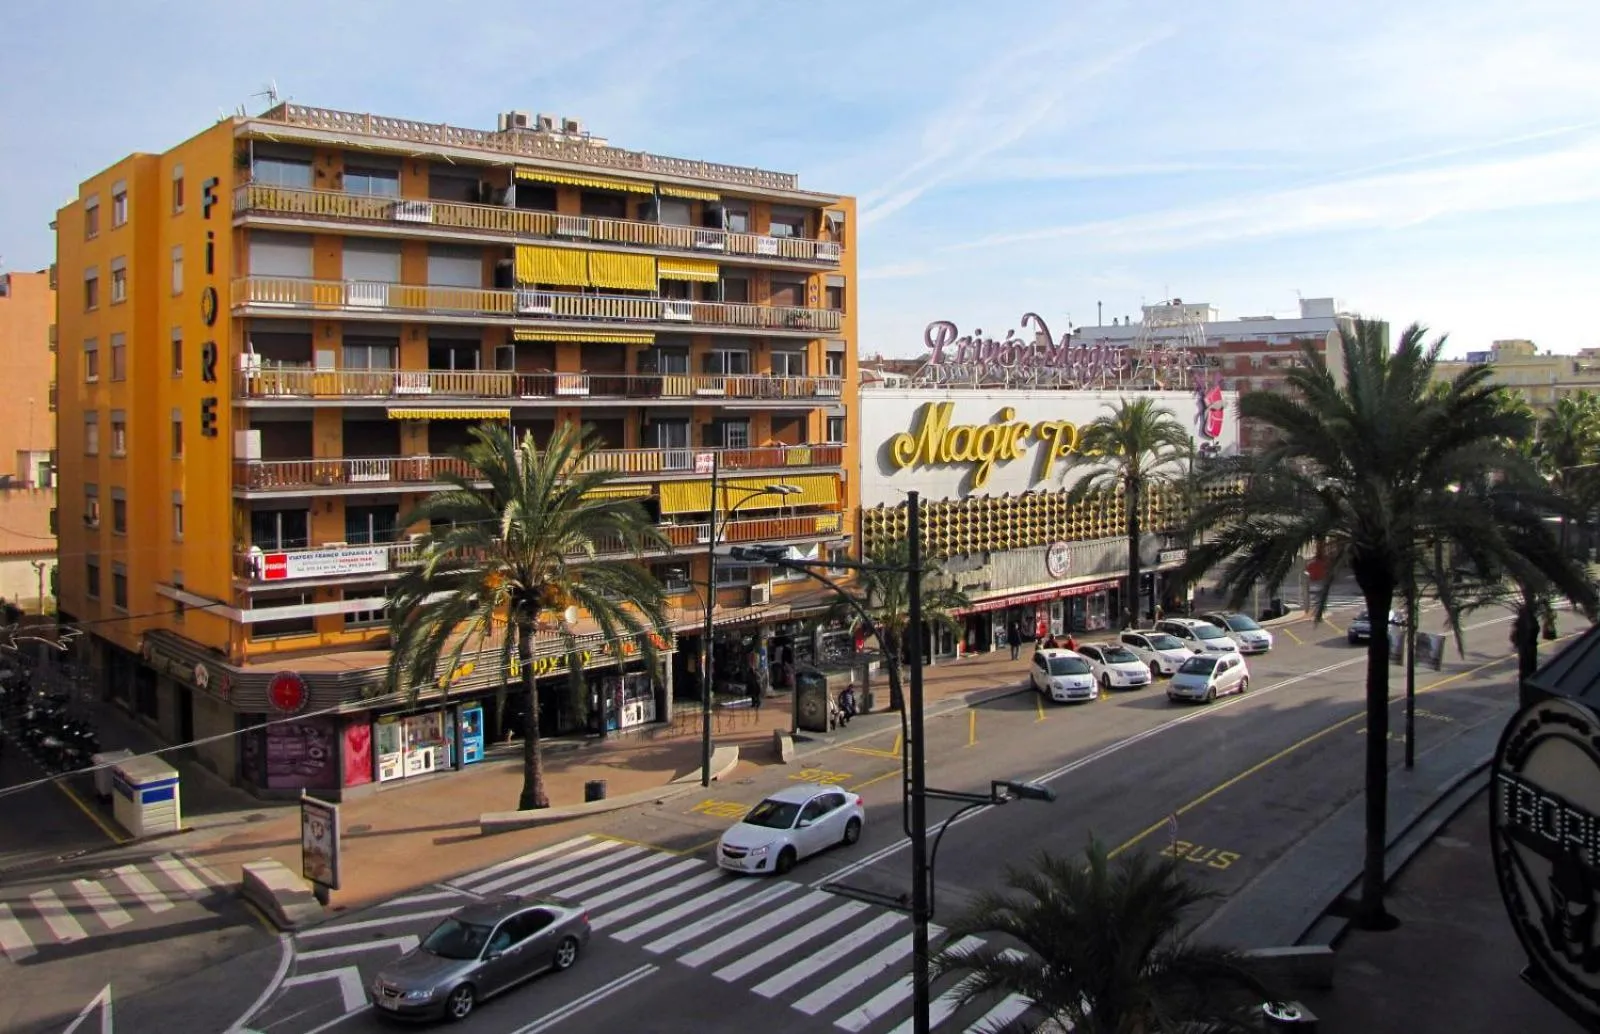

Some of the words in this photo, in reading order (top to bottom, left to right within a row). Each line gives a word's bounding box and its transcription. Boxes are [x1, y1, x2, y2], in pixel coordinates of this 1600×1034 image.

[893, 400, 1031, 489] Magic
[1160, 840, 1242, 869] BUS
[1497, 773, 1600, 865] TROPI
